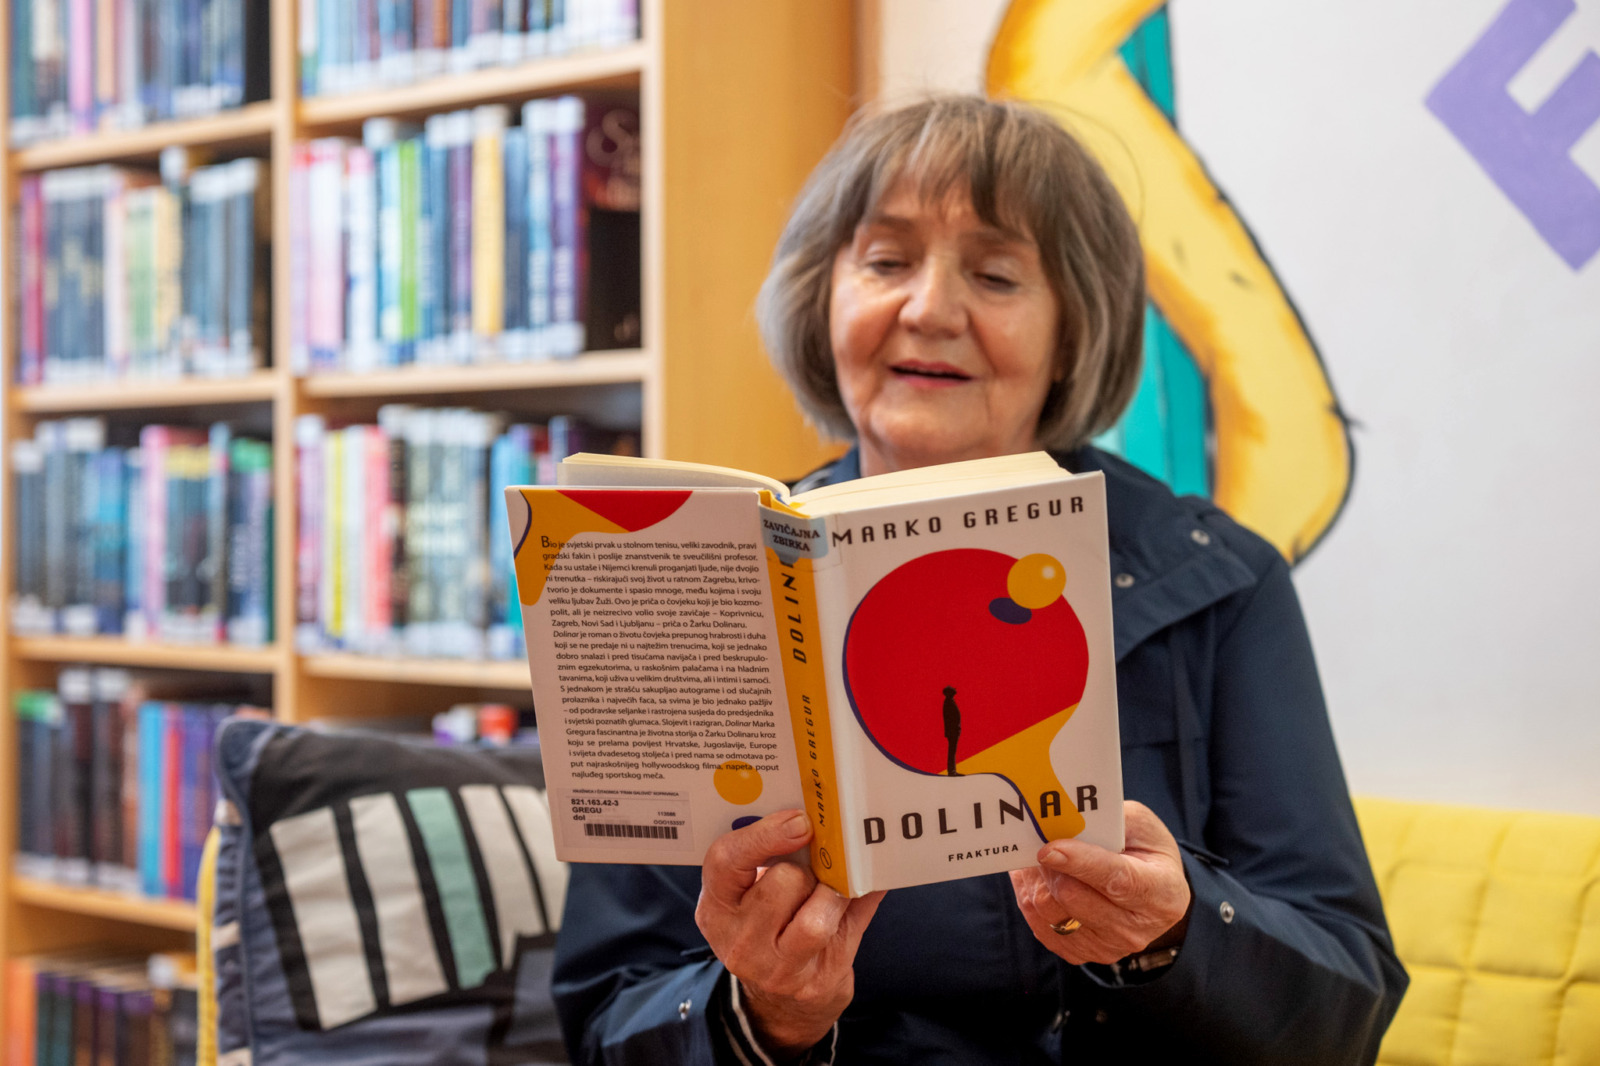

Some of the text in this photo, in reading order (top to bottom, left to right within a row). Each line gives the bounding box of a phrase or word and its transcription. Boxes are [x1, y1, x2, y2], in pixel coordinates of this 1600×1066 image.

[832, 495, 1084, 547] MARKO GREGUR
[763, 519, 821, 540] ZAVIČAJNA
[540, 535, 757, 551] Bio svjetski prvak stolnom tenisu, veliki zavodnik, pravi
[772, 534, 811, 552] ZBIRKA
[541, 551, 758, 562] gradski fakin poslije znanstvenik sveučilišni profesor.
[543, 562, 759, 574] Kada ustaše Nijemci krenuli proganjati ljude, nije dvojio
[553, 574, 760, 585] trenutka riskirajući svoj život ratnom Zagrebu, krivo-
[546, 585, 762, 596] tvorio dokumente spasio mnoge, među kojima svoju
[547, 596, 571, 604] veliku
[570, 596, 595, 606] ljubav
[639, 597, 659, 607] priča
[665, 597, 696, 607] čovjeku
[696, 597, 711, 607] koji
[733, 598, 762, 606] kozmo-
[549, 607, 764, 619] polit, neizrecivo volio svoje zavičaje Koprivnicu,
[551, 618, 747, 629] Zagreb, Novi Ljubljanu priča Žarku Dolinaru.
[552, 629, 579, 638] Dolinar
[618, 630, 642, 638] životu
[641, 630, 671, 640] čovjeka
[670, 632, 708, 641] prepunog
[708, 631, 742, 639] hrabrosti
[746, 631, 766, 640] duha
[553, 641, 768, 652] koji predaje najtežim trenucima, koji jednako
[555, 652, 768, 663] dobro snalazi pred tisućama navijača pred beskrupulo-
[556, 662, 770, 674] znim egzekutorima, raskošnim palačama hladnim
[558, 673, 594, 683] tavanima,
[594, 674, 609, 683] koji
[608, 674, 629, 682] uživa
[635, 674, 662, 683] velikim
[715, 675, 738, 684] intimi
[565, 684, 772, 696] jednakom strašću sakupljao autograme slučajnih
[561, 695, 773, 707] prolaznika najvećih faca, svima jednako pažljiv
[579, 706, 774, 718] podravske seljanke rastrojena susjeda predsjednika
[567, 717, 775, 728] svjetski poznatih glumaca. Slojevit razigran, Dolinar Marka
[565, 728, 776, 739] Gregura fascinantna životna storija Žarku Dolinaru kroz
[567, 738, 777, 751] koju prelama povijest Hrvatske, Jugoslavije, Europe
[572, 749, 596, 759] svijeta
[596, 749, 641, 759] dvadesetog
[641, 750, 670, 760] stoljeća
[674, 751, 693, 760] pred
[724, 751, 763, 760] odmotava
[585, 760, 779, 772] najraskošnijeg hollywoodskog filma, napeta poput
[801, 694, 825, 828] MARKO GREGUR
[571, 770, 604, 780] najluđeg
[604, 771, 642, 780] sportskog
[571, 798, 619, 807] 821.163.42-3
[572, 806, 602, 814] GREGU
[863, 784, 1099, 845] DOLINAR
[948, 844, 1019, 862] FRAKTURA
